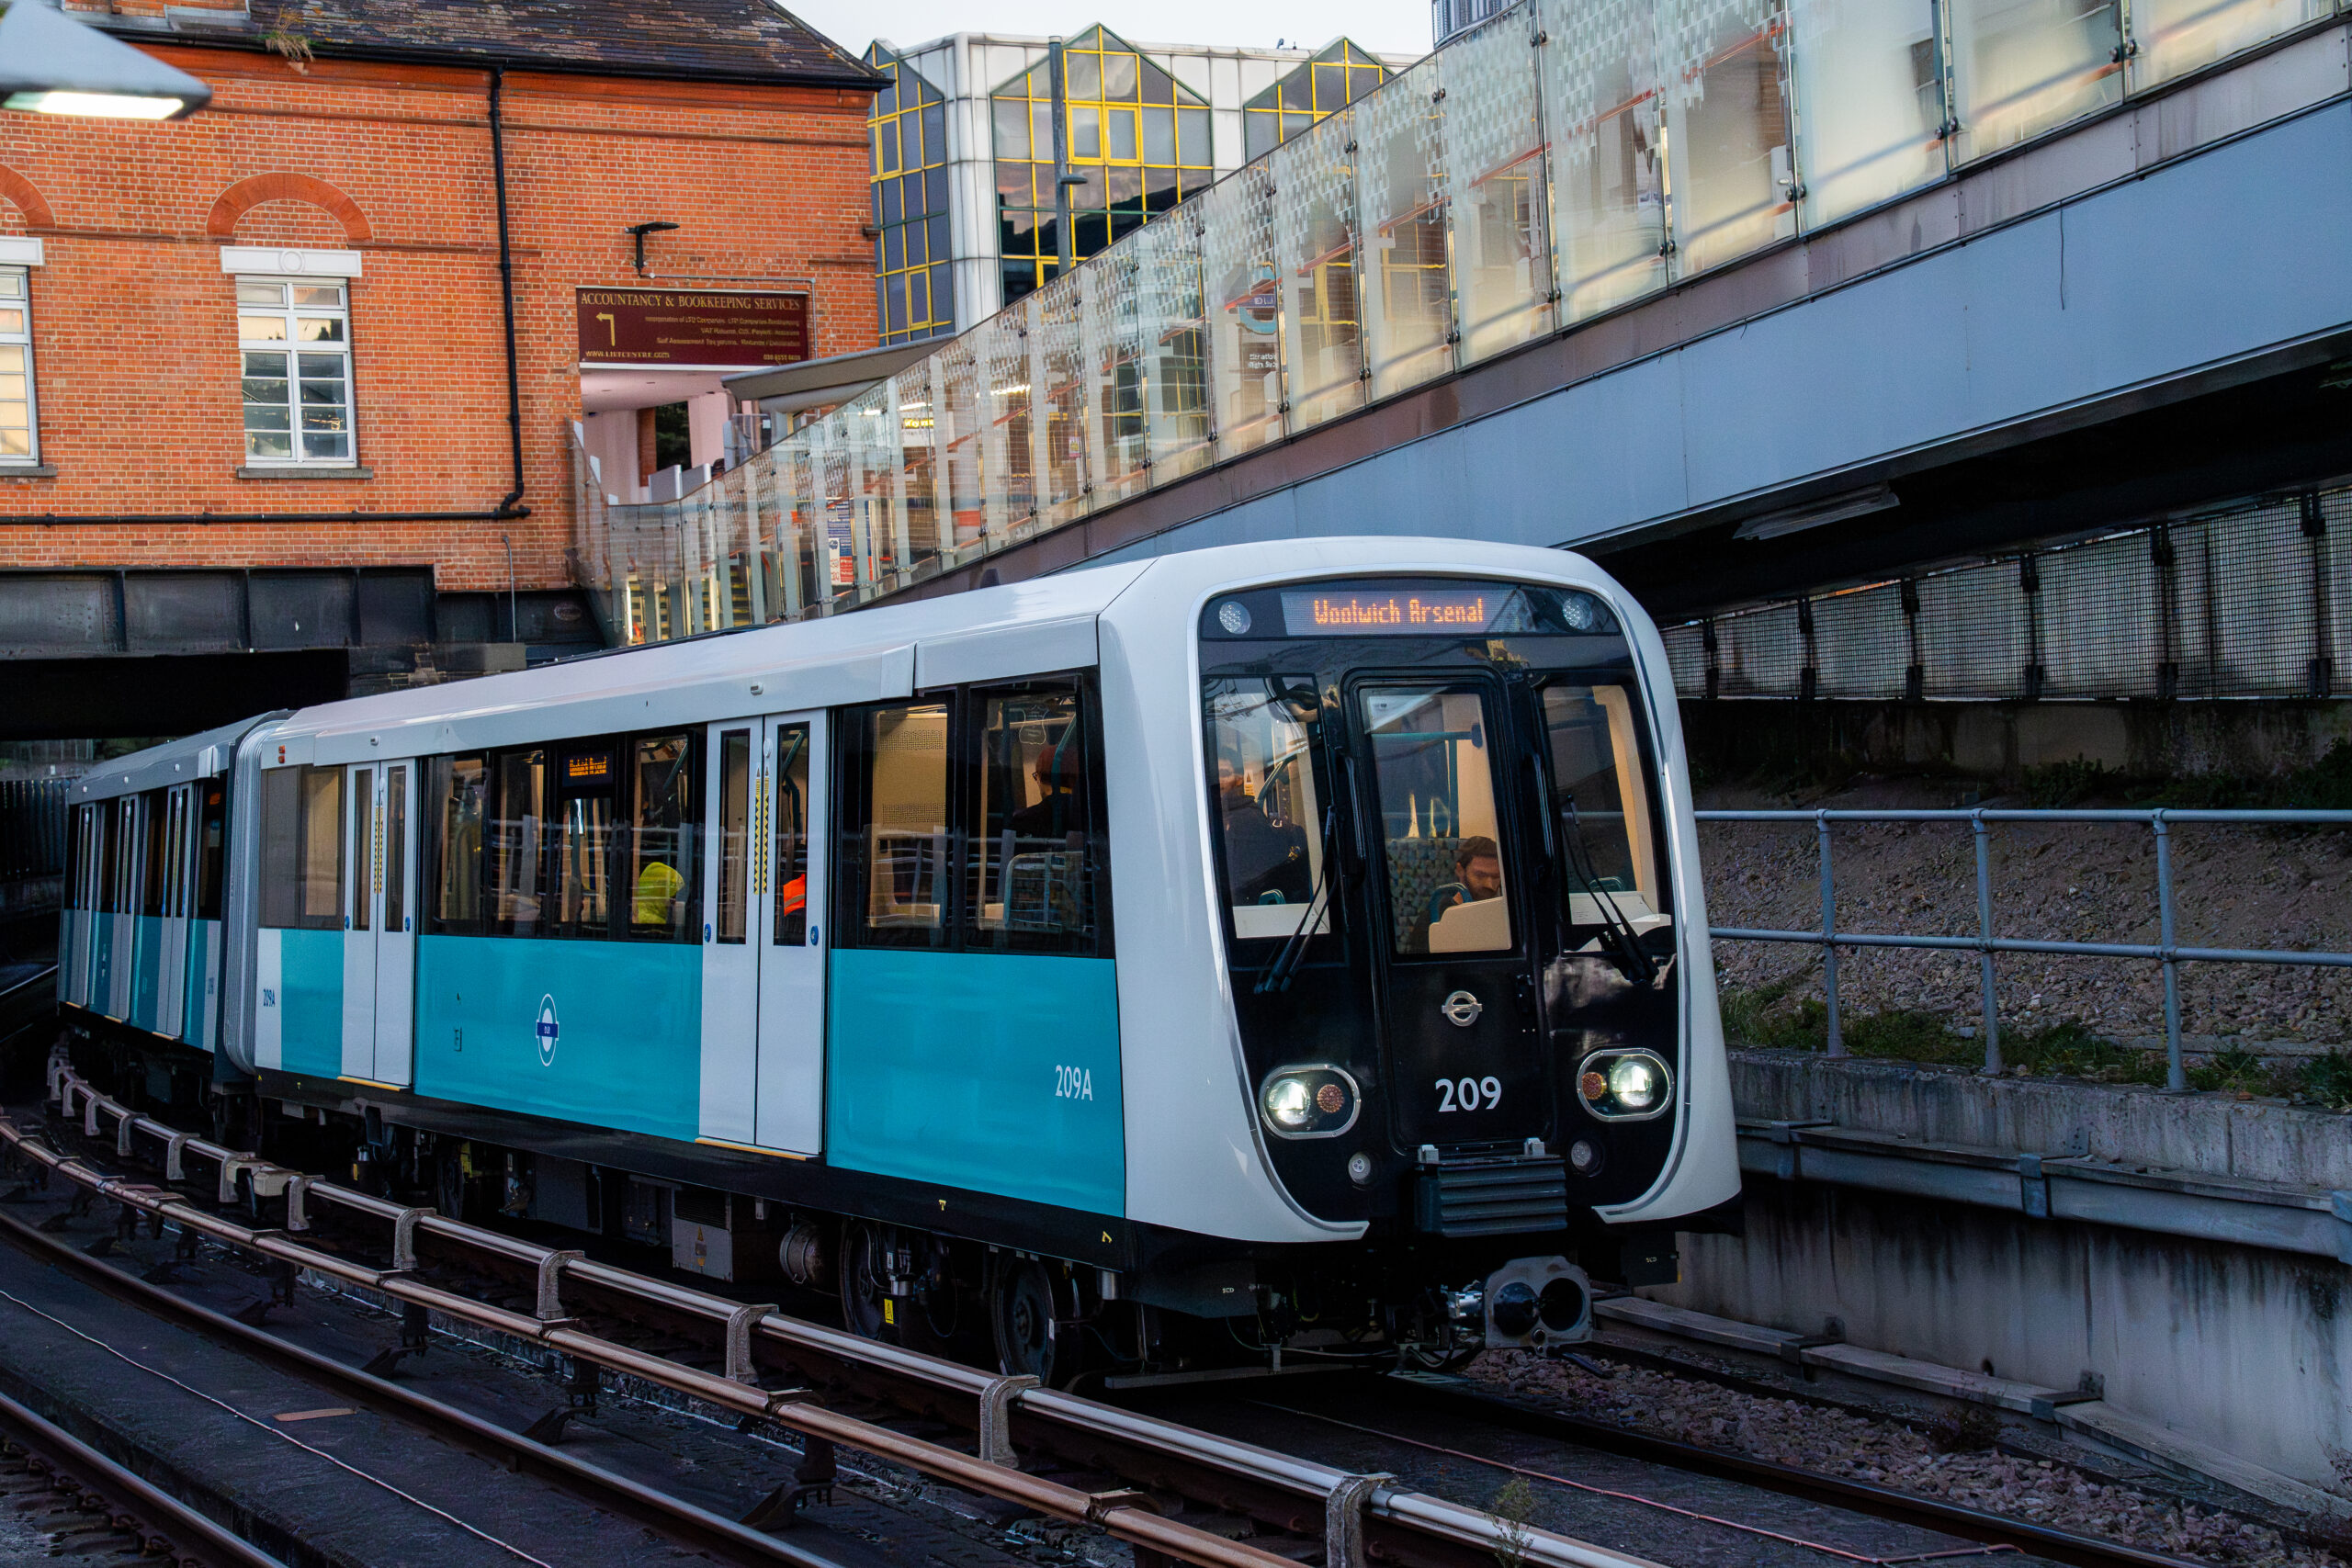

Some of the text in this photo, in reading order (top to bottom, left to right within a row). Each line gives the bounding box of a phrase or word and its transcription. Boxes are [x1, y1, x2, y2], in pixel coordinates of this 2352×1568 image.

[582, 293, 800, 310] ACCOUNTANCY & BOOKKEEPING SERVICES
[1314, 598, 1484, 624] Woolwich Arsenal
[1055, 1064, 1093, 1101] 209A
[1435, 1076, 1502, 1112] 209
